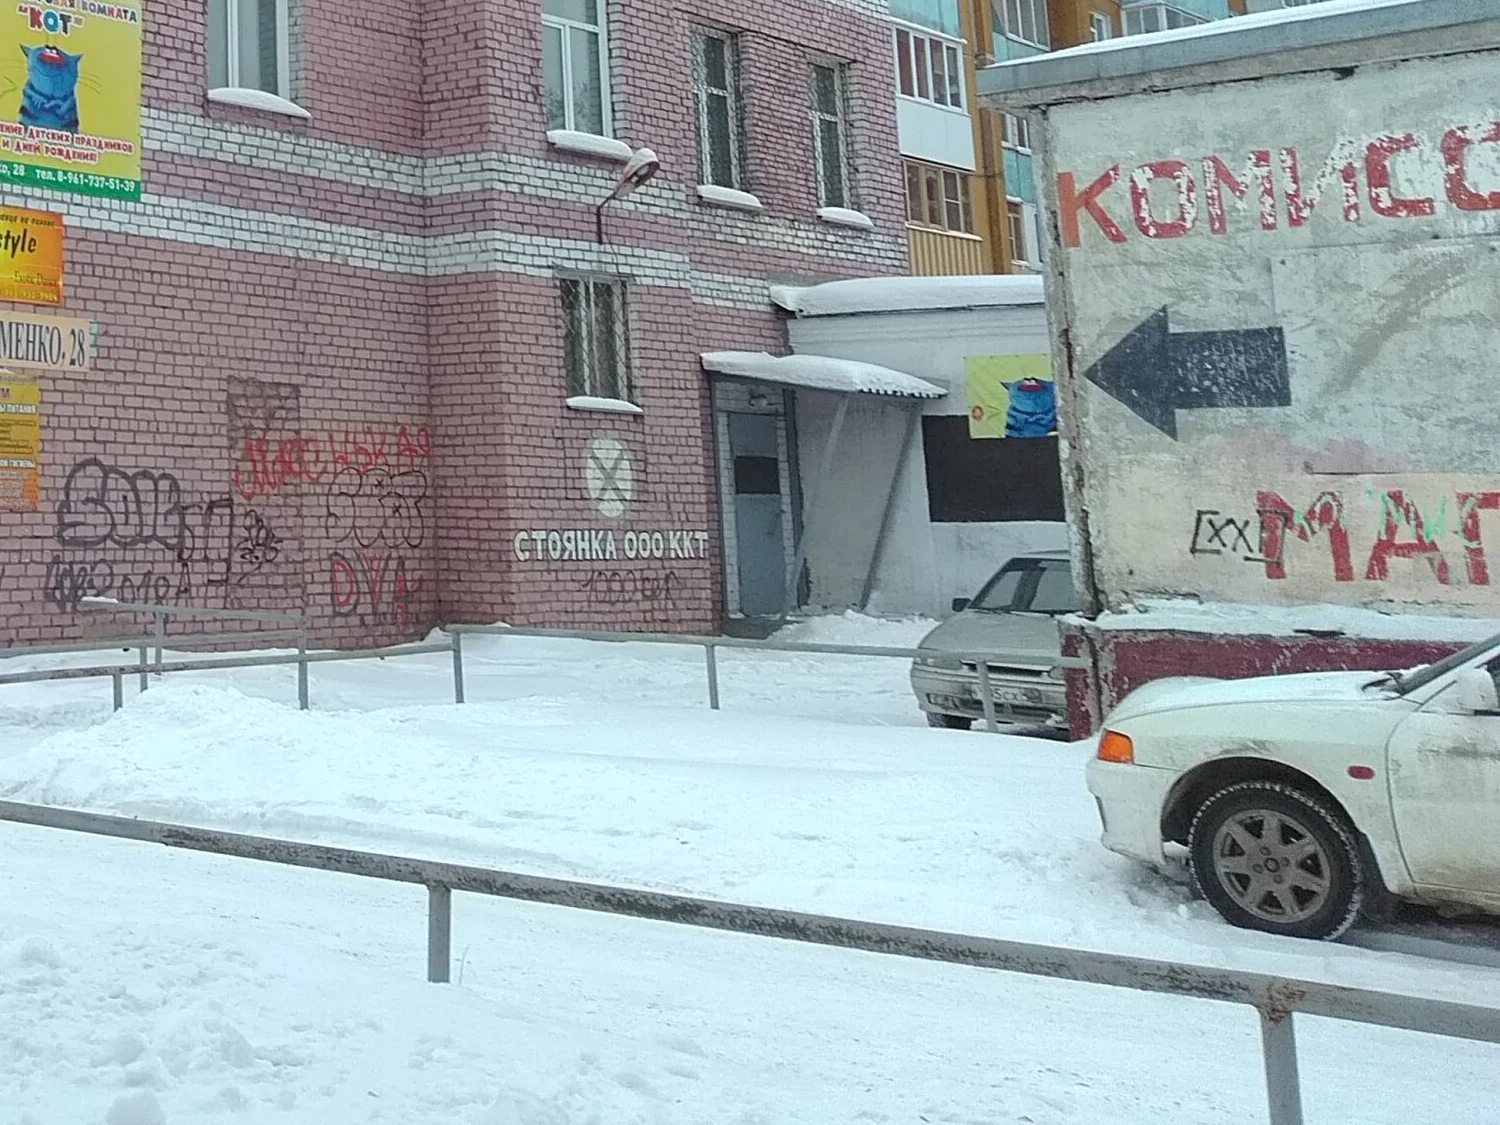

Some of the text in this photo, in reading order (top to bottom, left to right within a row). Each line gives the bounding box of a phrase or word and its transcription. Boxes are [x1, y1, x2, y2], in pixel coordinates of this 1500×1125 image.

[81, 0, 137, 23] КОМНАТА
[2, 139, 10, 149] И
[15, 139, 41, 155] ДНЕЙ
[28, 128, 72, 144] ДЕТСКИХ
[74, 135, 134, 154] ПРАЗДНИКОВ
[12, 163, 25, 176] 28
[35, 168, 56, 182] тел.
[57, 171, 136, 193] 8-961-737-51-39
[69, 328, 86, 367] 28
[514, 530, 709, 562] СТОЯНКА ООО ККТ
